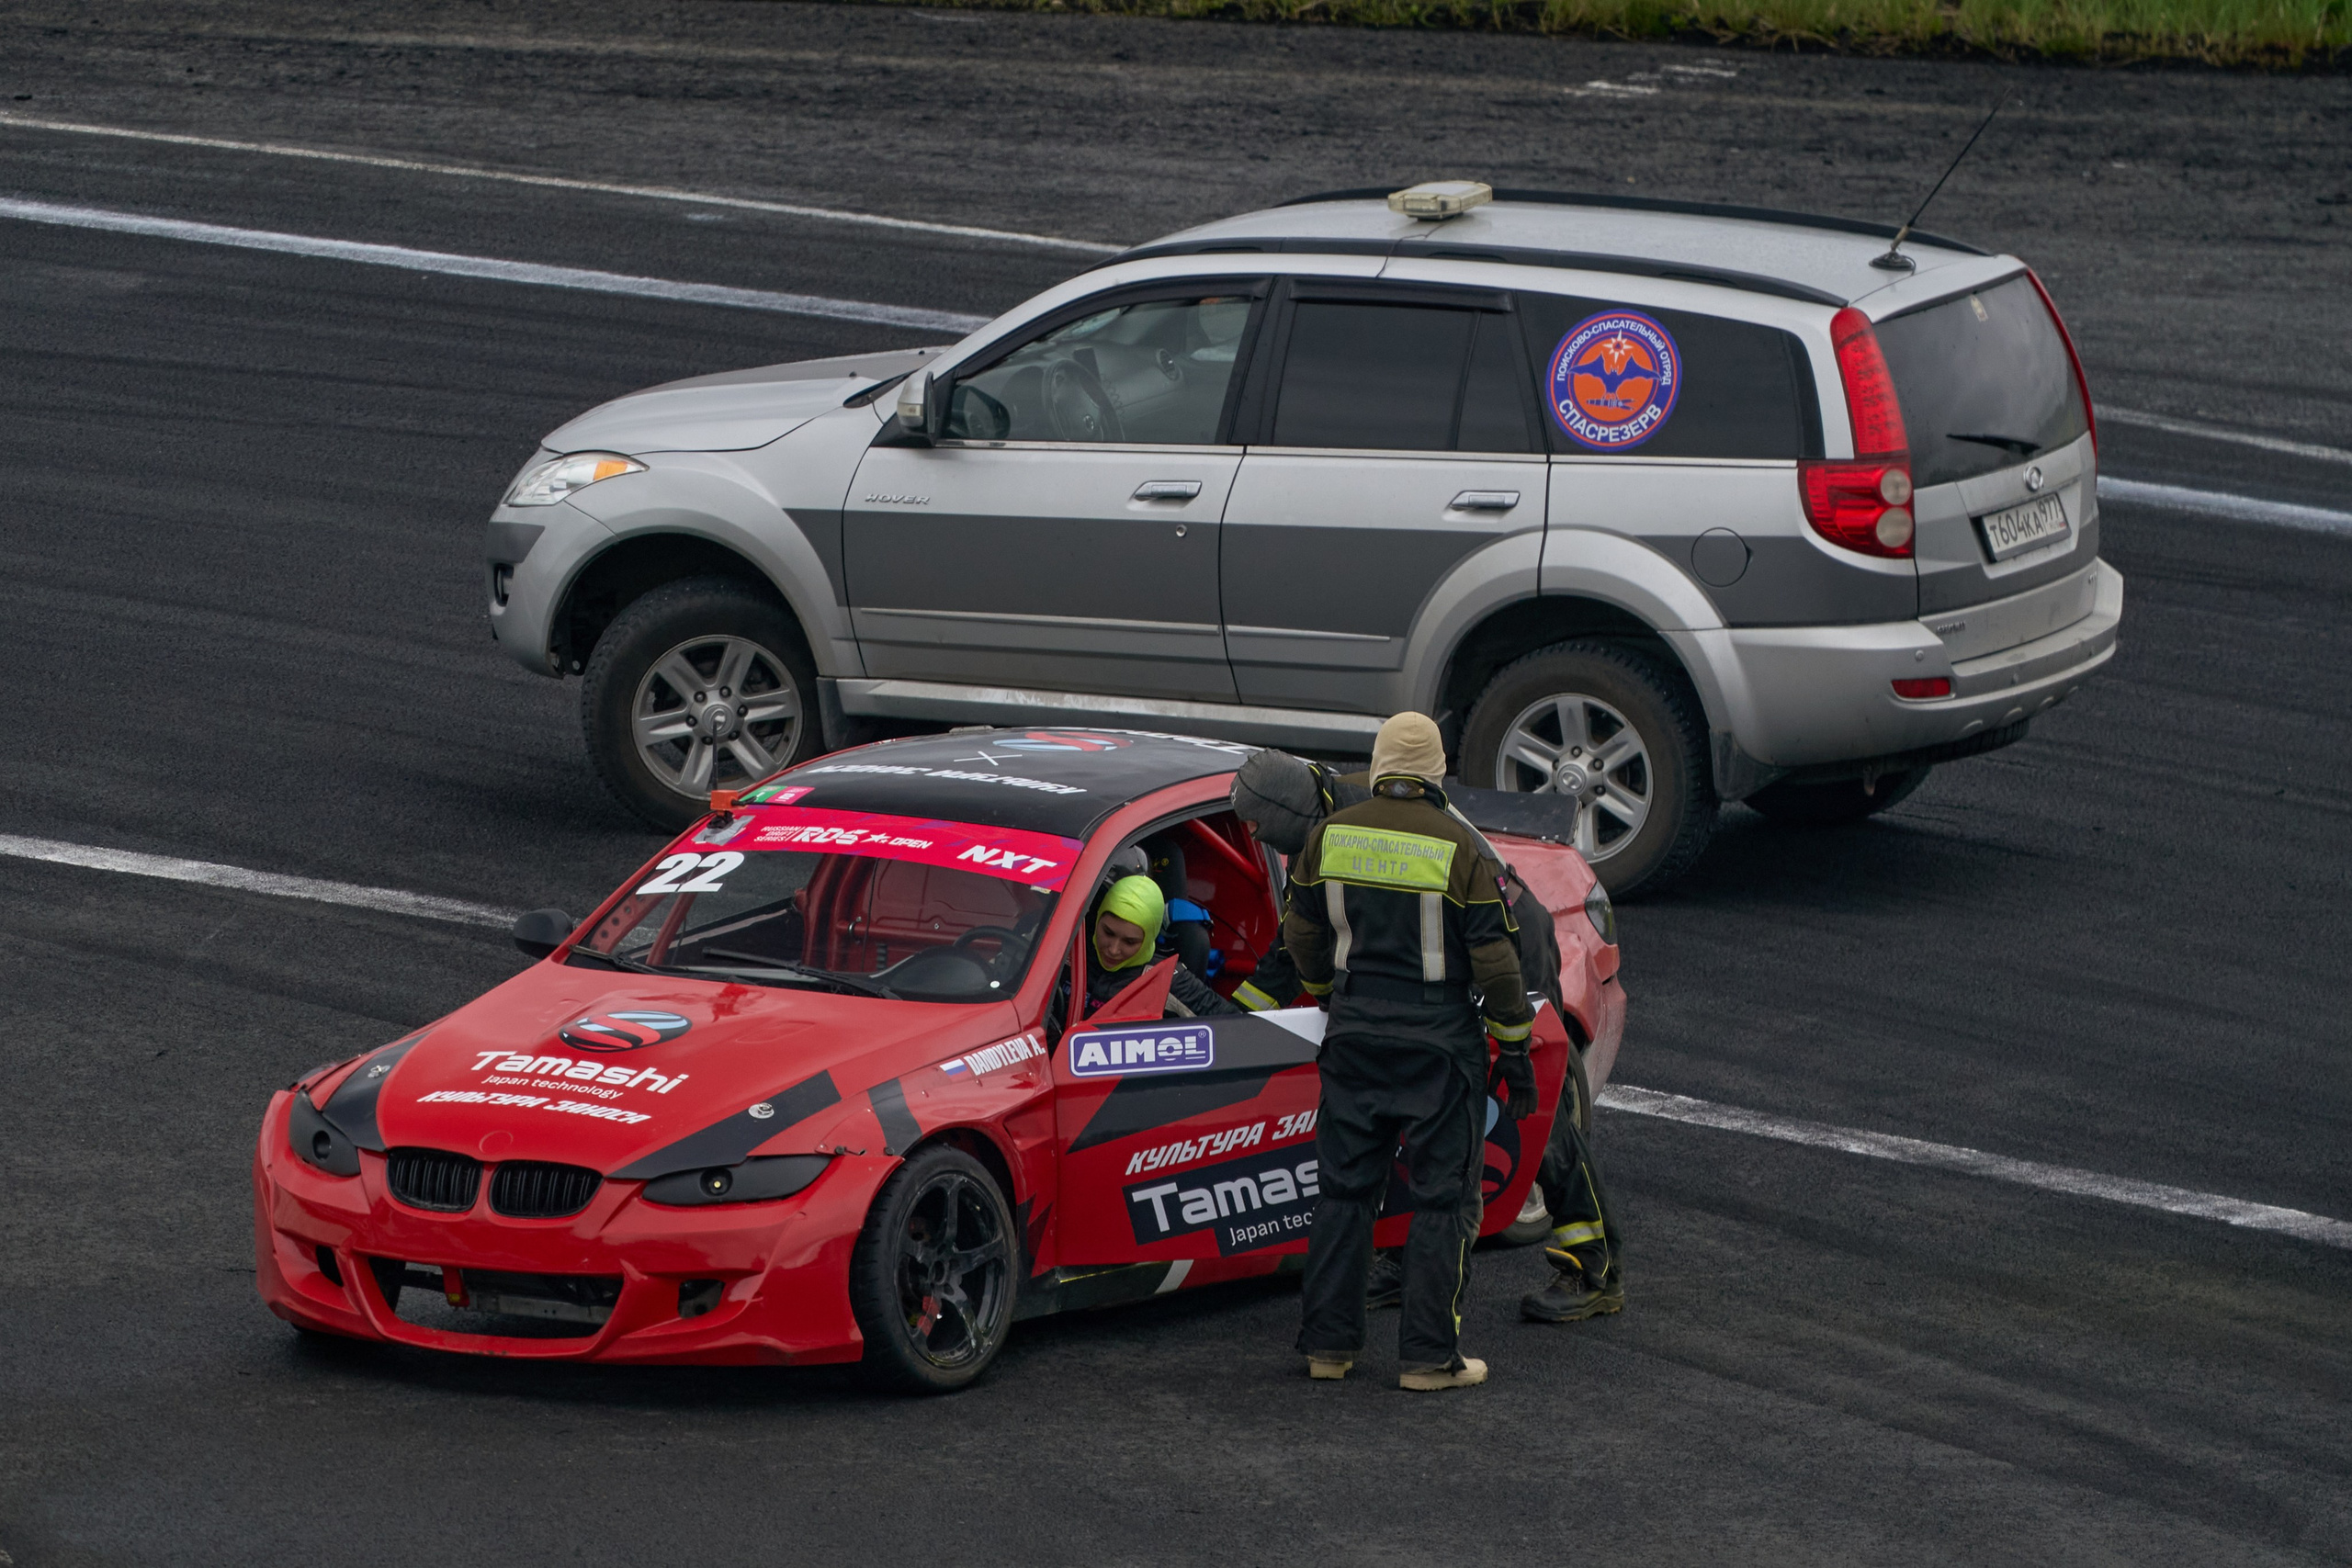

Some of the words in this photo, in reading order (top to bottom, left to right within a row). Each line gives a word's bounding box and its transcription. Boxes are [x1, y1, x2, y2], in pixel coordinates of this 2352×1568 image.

[1557, 320, 1666, 381] ПОИСКОВО-СПАСАТЕЛЬНЫЙ
[1659, 351, 1672, 386] ОТРЯД
[1559, 399, 1661, 443] СПАСРЕЗЕРВ
[865, 494, 931, 505] HOVER
[888, 838, 933, 850] OPEN
[956, 844, 1057, 874] NXT
[1329, 833, 1445, 862] ПОЖАРНО-СПАСАТЕЛЬНЫЙ
[635, 851, 745, 896] 22
[1352, 856, 1408, 875] ЦЕНТР
[1077, 1035, 1206, 1067] AIMOL
[470, 1051, 689, 1094] Tamashi
[532, 1077, 624, 1100] technology
[416, 1090, 550, 1108] КУЛЬТУРА
[543, 1100, 651, 1124] ЗАНОСА
[1125, 1122, 1266, 1176] КУЛЬТУРА
[1229, 1220, 1280, 1246] Japan
[1283, 1206, 1316, 1230] tec
